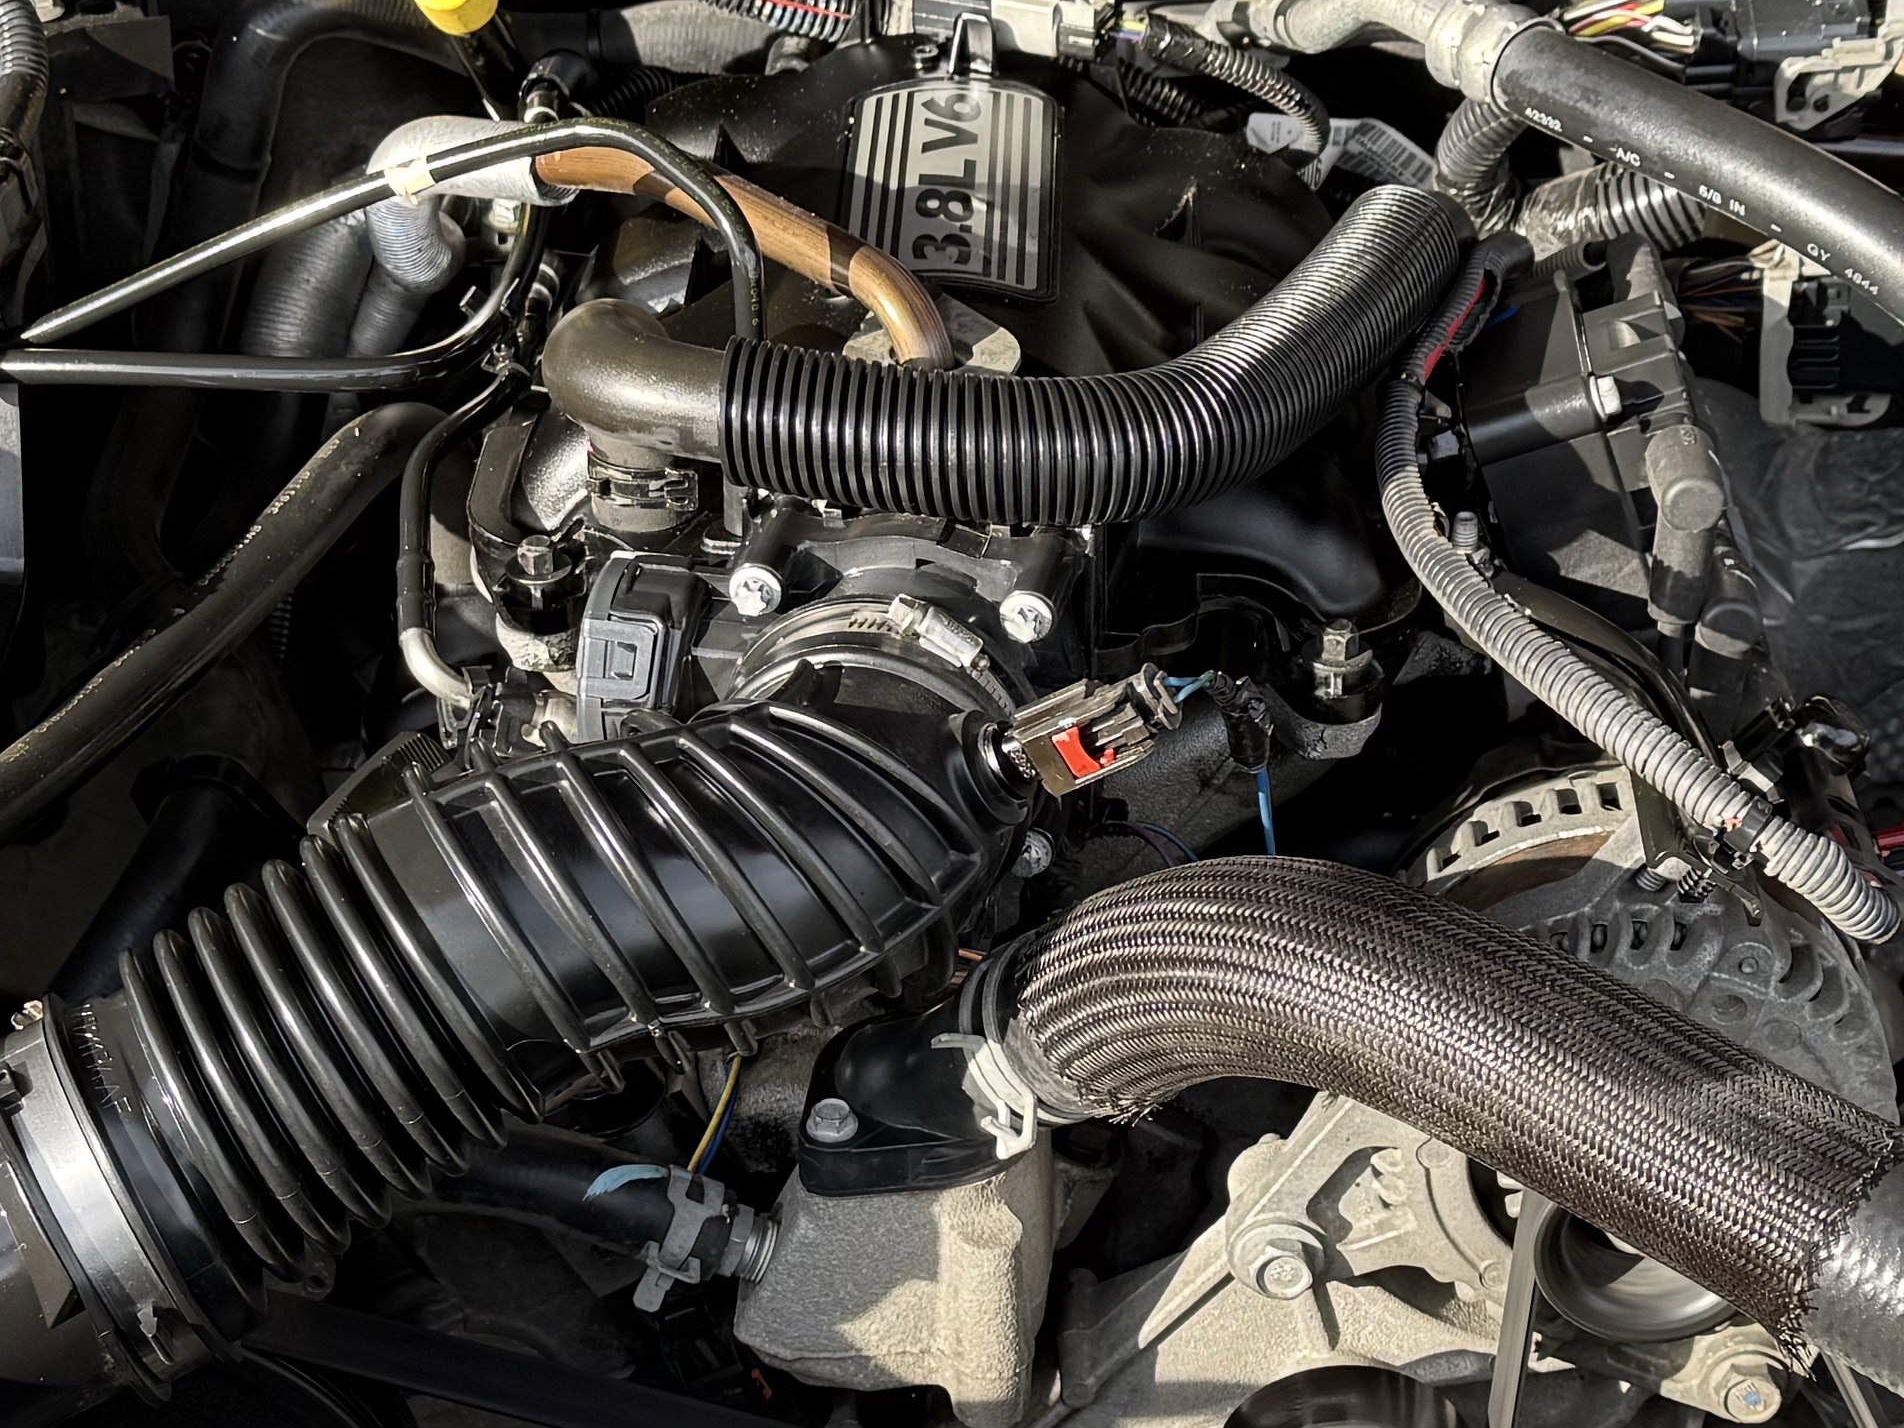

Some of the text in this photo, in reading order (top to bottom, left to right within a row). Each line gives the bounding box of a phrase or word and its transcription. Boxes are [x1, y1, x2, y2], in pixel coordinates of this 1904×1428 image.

[1614, 146, 1642, 167] A/C
[1728, 198, 1747, 217] IN
[1805, 241, 1832, 264] GY
